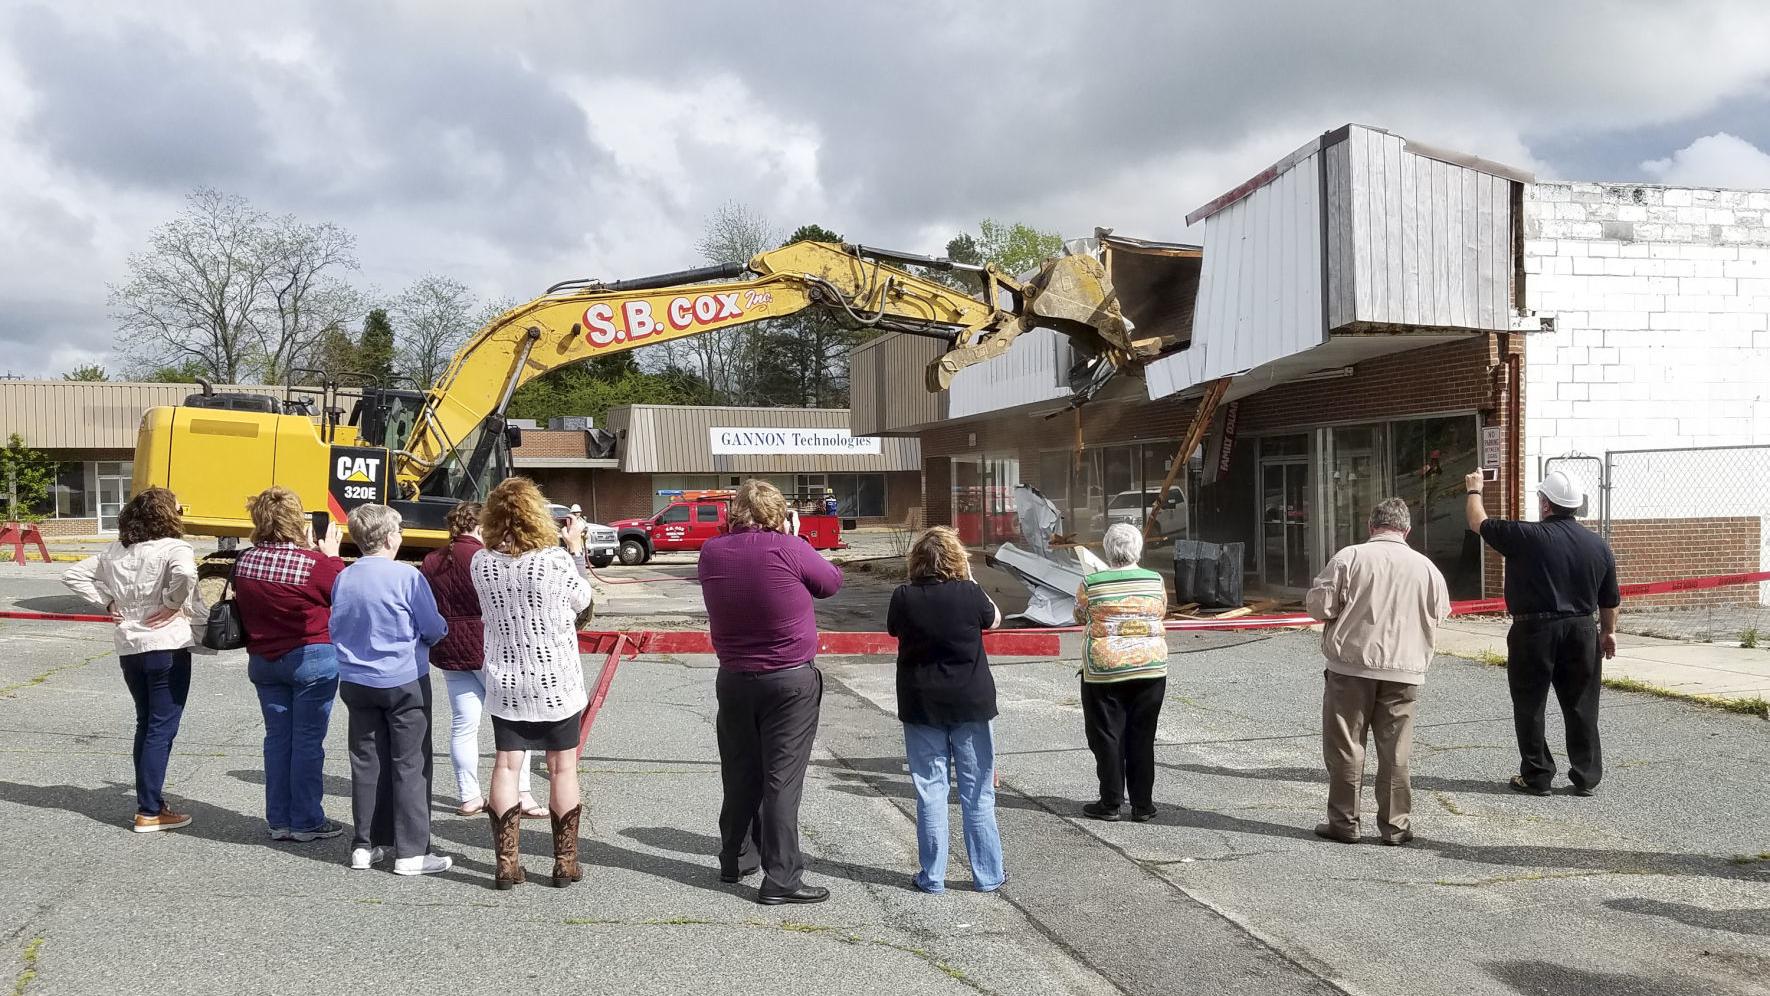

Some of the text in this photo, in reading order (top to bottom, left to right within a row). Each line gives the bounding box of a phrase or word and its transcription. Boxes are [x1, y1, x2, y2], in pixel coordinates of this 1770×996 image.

[583, 300, 664, 348] S.B.
[668, 292, 744, 330] COX
[721, 432, 871, 449] GANNON Technologies
[1220, 436, 1232, 472] FAMILY
[336, 456, 380, 482] CAT
[344, 486, 376, 500] 320E
